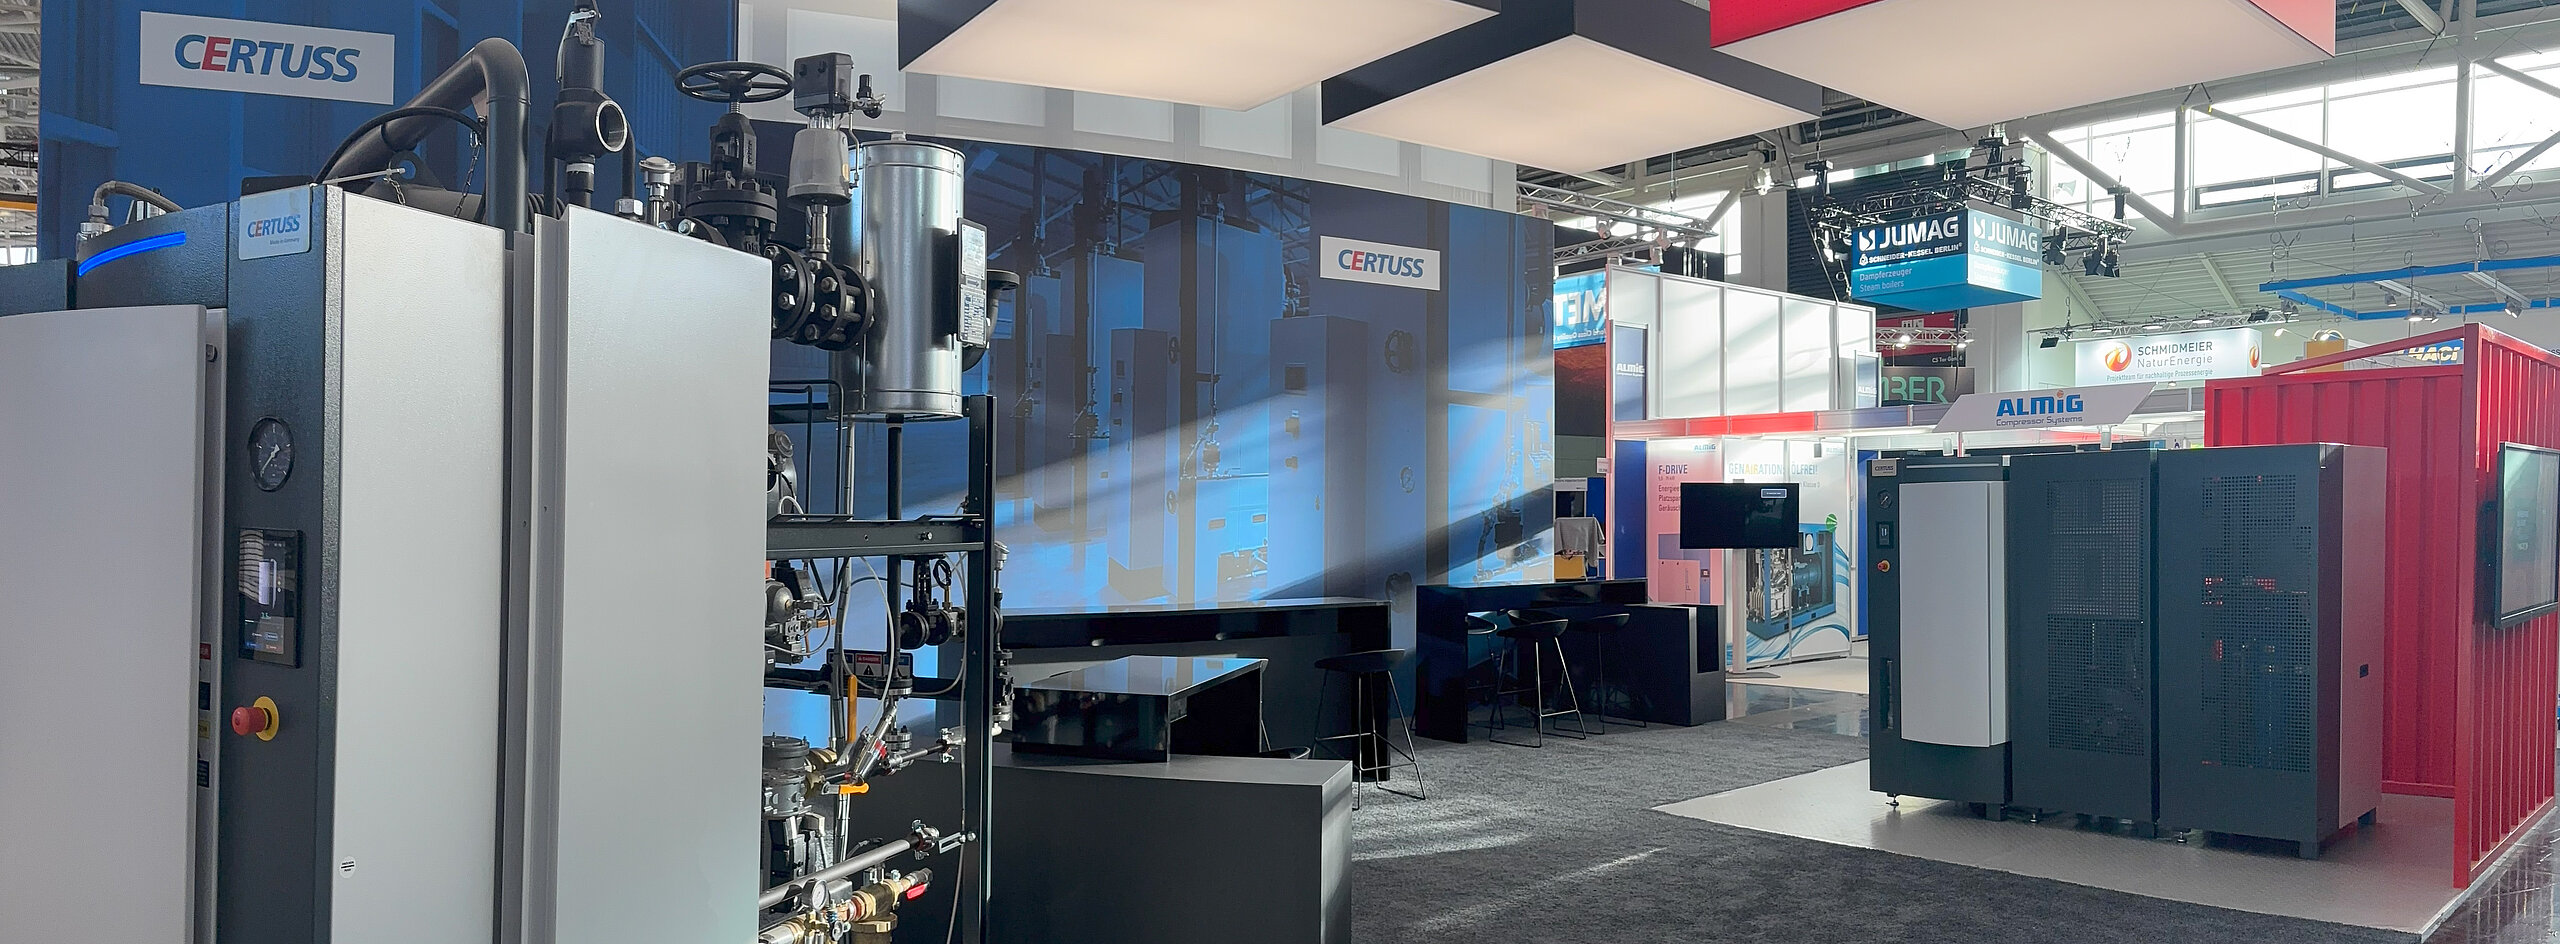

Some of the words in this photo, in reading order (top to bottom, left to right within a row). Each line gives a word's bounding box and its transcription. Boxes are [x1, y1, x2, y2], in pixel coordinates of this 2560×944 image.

[174, 33, 361, 83] CERTUSS
[247, 214, 301, 238] CERTUSS
[1879, 215, 1959, 249] JUMAG
[1987, 221, 2038, 253] JUMAG
[1338, 249, 1425, 279] CERTUSS
[1868, 248, 1933, 264] SCHNEIDER-KESSEL
[1859, 268, 1912, 281] Dampferzeuger
[1859, 283, 1880, 293] Steam
[1881, 280, 1905, 290] boilers
[2137, 341, 2213, 357] SCHMIDMEIER
[2137, 354, 2213, 369] NaturEnergie
[2106, 373, 2136, 382] Projektteam
[2144, 371, 2174, 380] nachhaltige
[2174, 369, 2213, 377] Prozessenergie
[1996, 418, 2045, 428] Compressor
[2046, 416, 2083, 426] Systems
[1658, 464, 1688, 475] F-DRIVE
